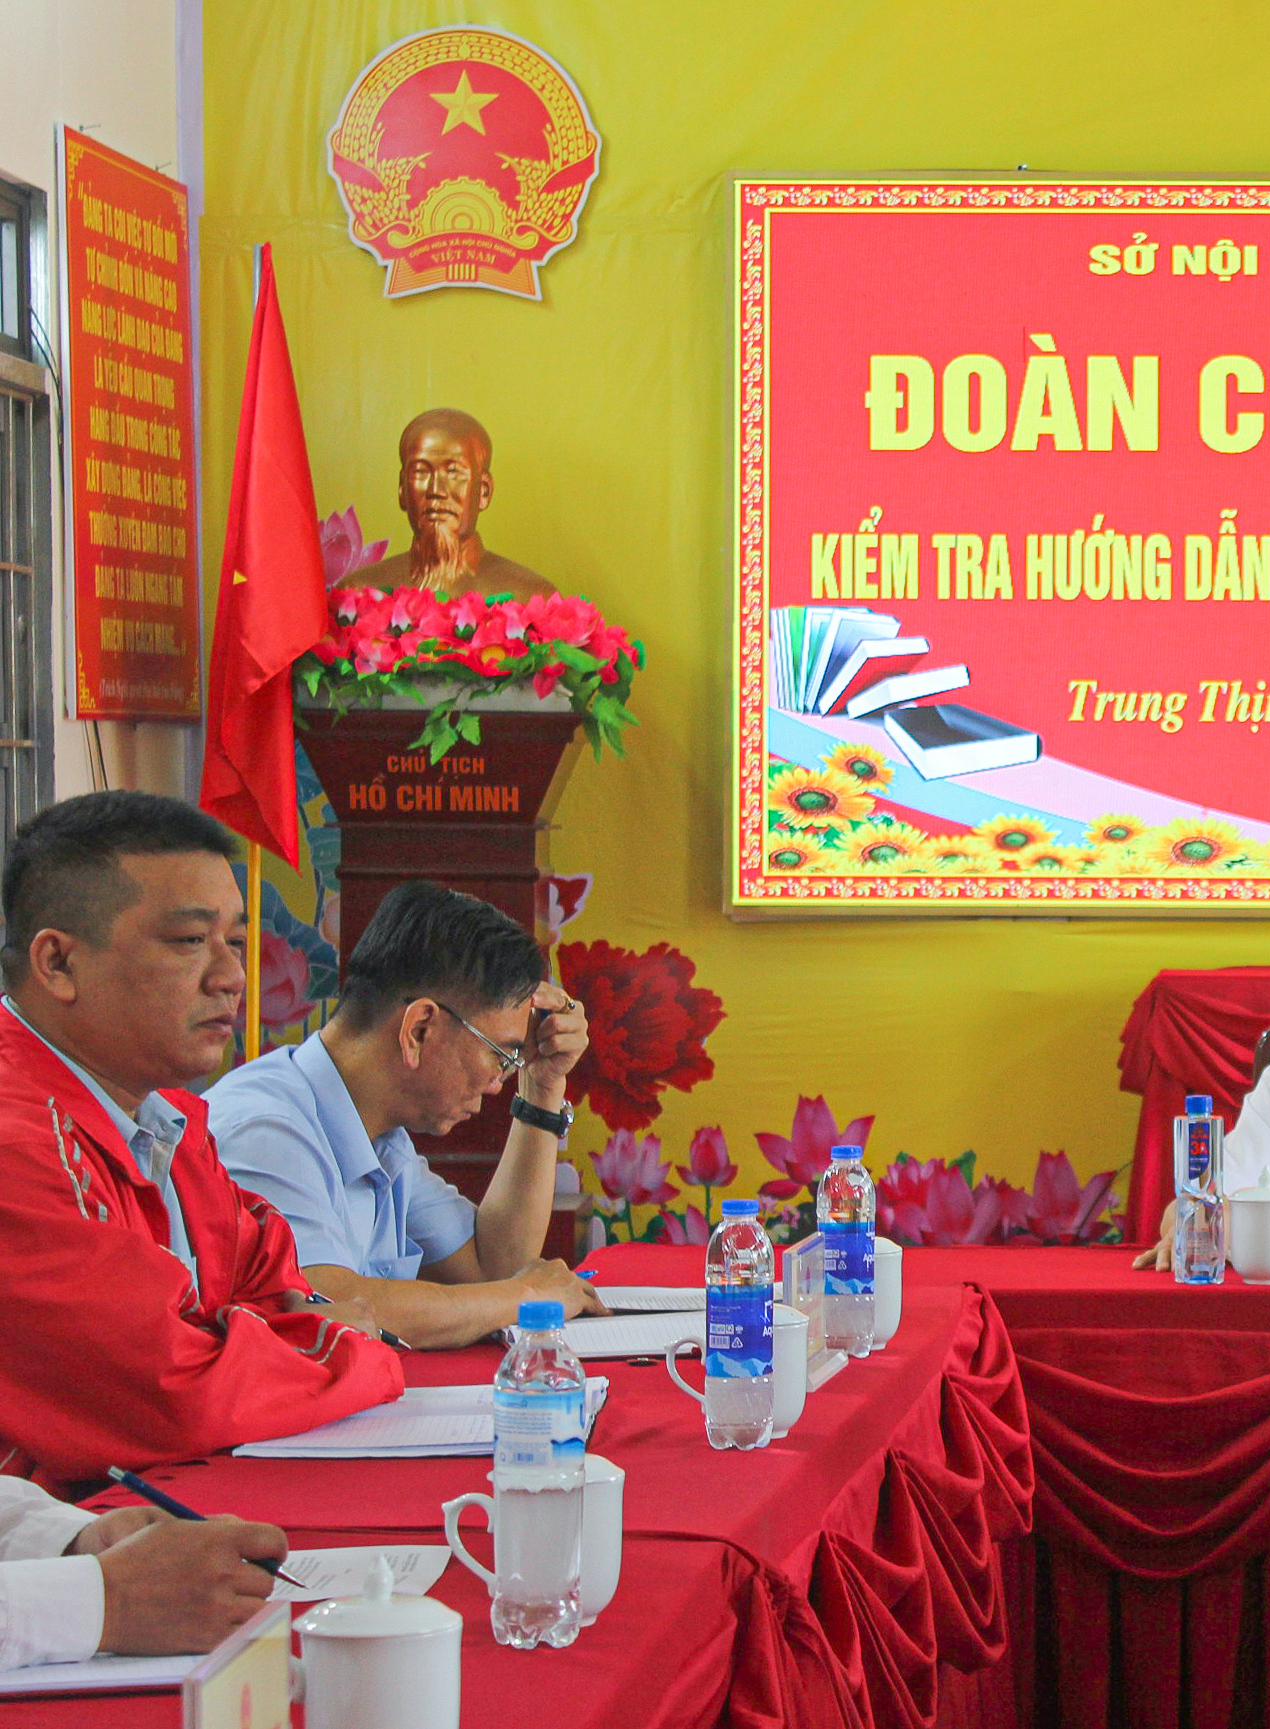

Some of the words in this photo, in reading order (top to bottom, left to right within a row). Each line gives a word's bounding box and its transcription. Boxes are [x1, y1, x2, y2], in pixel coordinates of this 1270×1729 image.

[103, 202, 114, 238] TA
[465, 249, 497, 265] NAM
[1089, 232, 1159, 277] SỞ
[1172, 240, 1258, 281] NỘI
[163, 278, 177, 314] CAO
[94, 348, 104, 390] LÀ
[865, 333, 1160, 453] ĐOÀN
[811, 506, 919, 601] KIỂM
[932, 533, 1014, 601] TRA
[1026, 512, 1172, 602] HƯỚNG
[1068, 679, 1188, 734] Trung
[387, 748, 426, 773] CHỦ
[440, 756, 486, 780] TỊCH
[350, 773, 387, 811] HỒ
[397, 776, 442, 812] CHÍ
[450, 786, 519, 812] MINH
